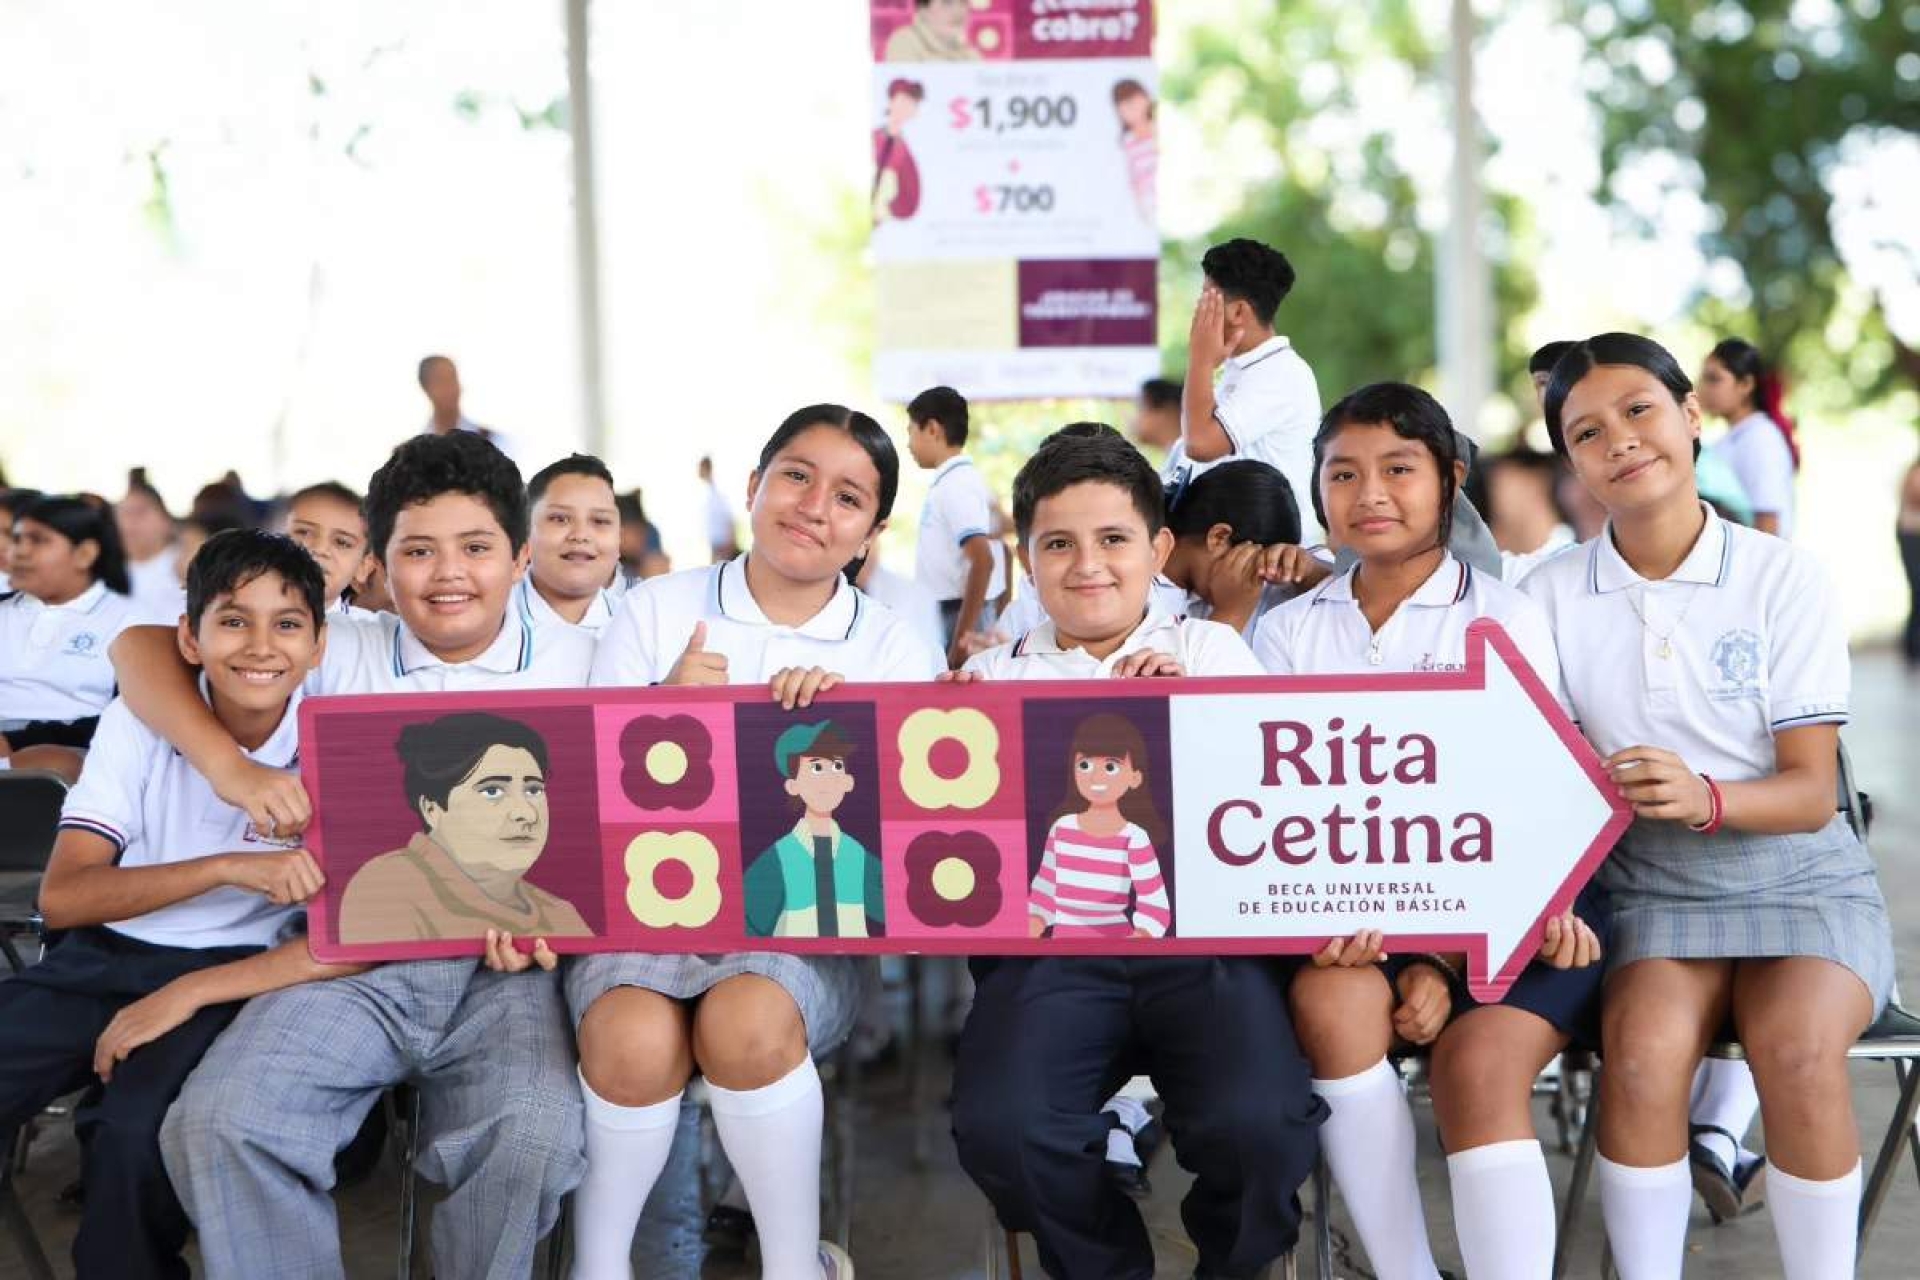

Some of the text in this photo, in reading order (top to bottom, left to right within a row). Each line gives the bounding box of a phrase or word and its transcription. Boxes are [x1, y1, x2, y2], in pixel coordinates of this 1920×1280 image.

[1031, 11, 1139, 42] cobro?
[949, 95, 1078, 134] $1,900
[974, 184, 1055, 213] $700
[1259, 717, 1437, 787] Rita
[1207, 796, 1493, 867] Cetina
[1268, 881, 1436, 896] BECA UNIVERSAL
[1239, 897, 1466, 915] DE EDUCACIÓN BÁSICA
